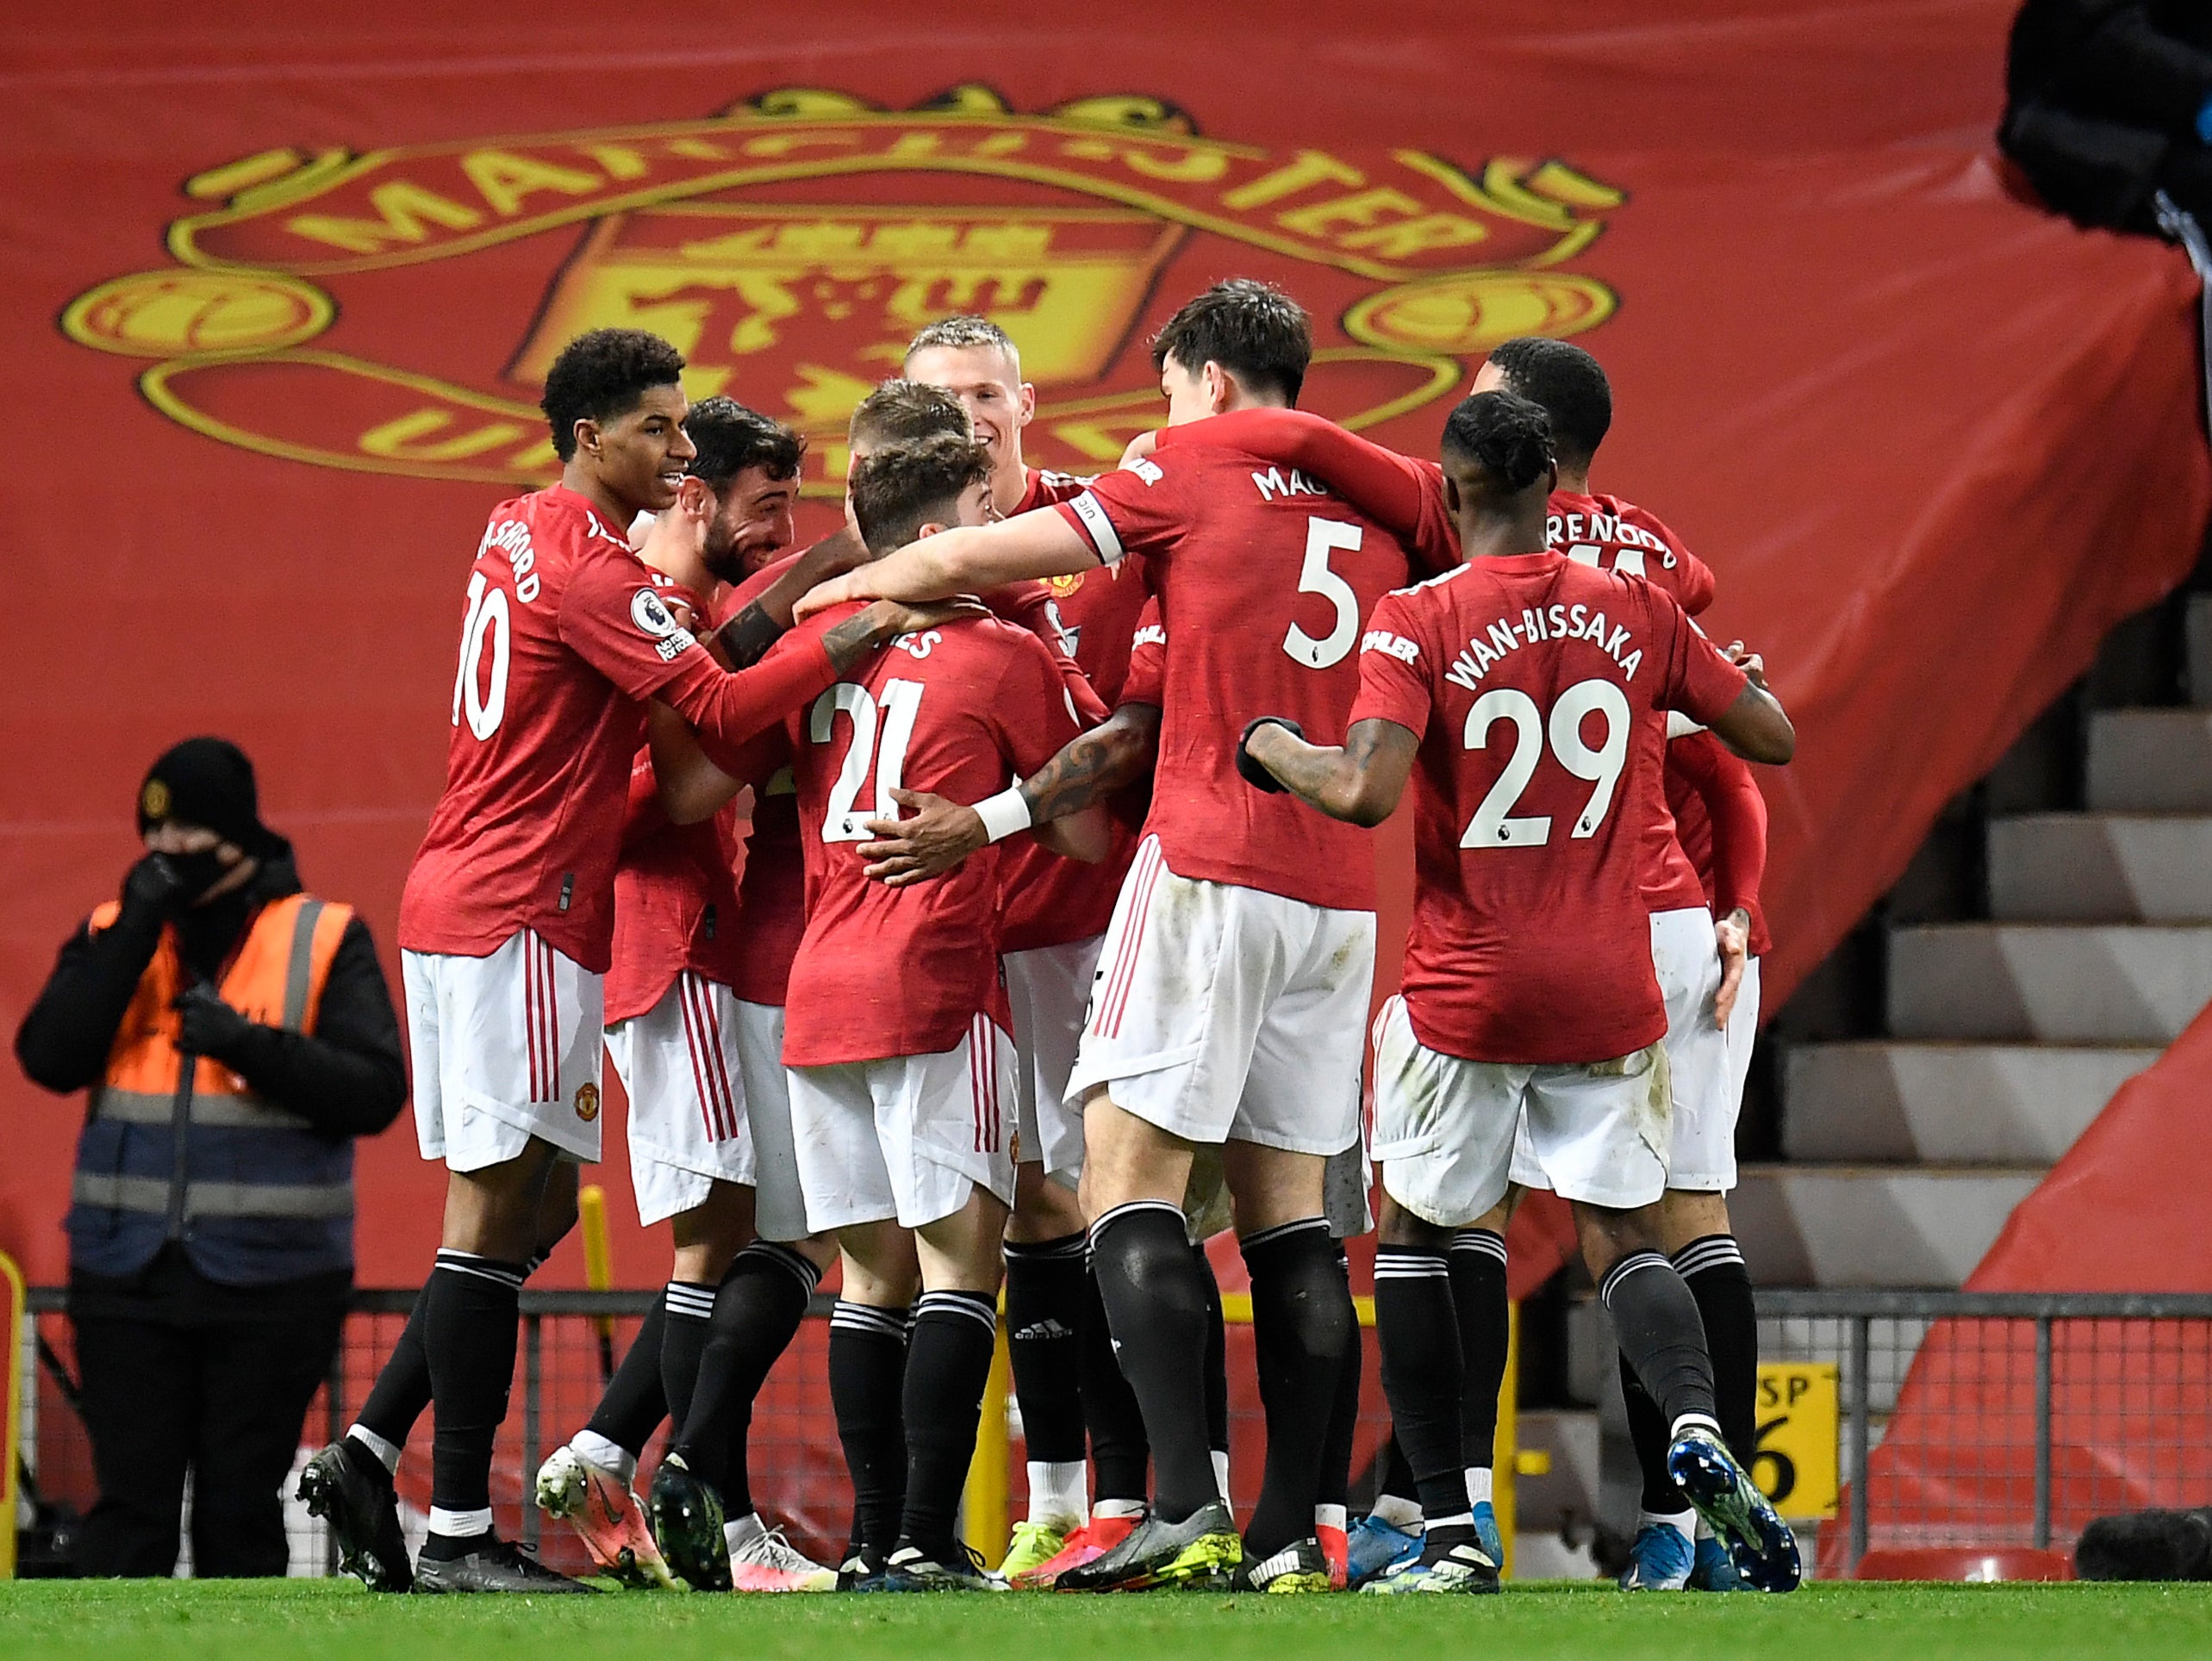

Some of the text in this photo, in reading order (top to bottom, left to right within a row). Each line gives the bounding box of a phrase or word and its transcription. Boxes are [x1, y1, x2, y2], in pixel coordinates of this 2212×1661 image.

[452, 570, 510, 741] 10
[1283, 516, 1362, 669] 5
[1445, 604, 1644, 691] WAN-BISSAKA
[811, 678, 925, 843] 21
[1460, 679, 1631, 849] 29
[1751, 1415, 1796, 1503] 6
